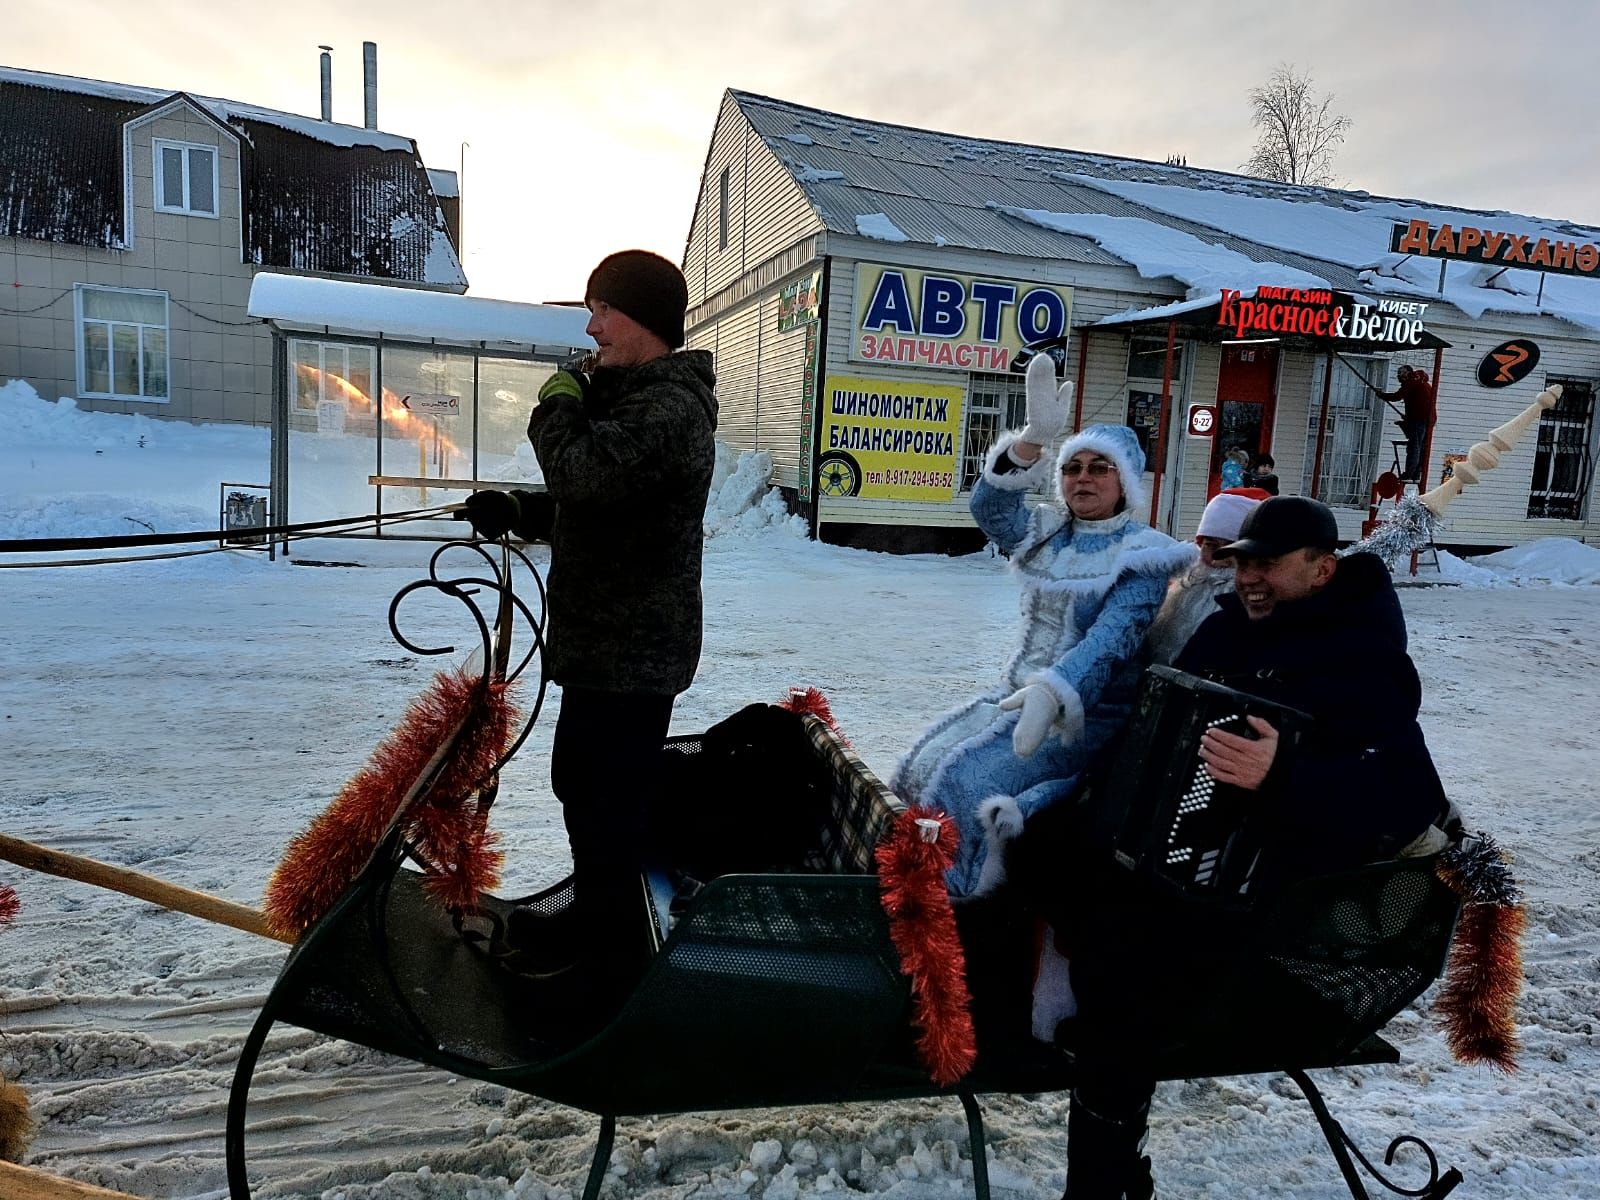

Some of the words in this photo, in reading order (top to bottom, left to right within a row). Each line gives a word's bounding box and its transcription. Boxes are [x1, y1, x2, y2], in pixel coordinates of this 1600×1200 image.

[1399, 219, 1599, 272] ДАРУХАНӘ
[861, 270, 1066, 344] АВТО
[1258, 286, 1332, 305] МАГАЗИН
[1379, 300, 1429, 316] КИБЕТ
[860, 335, 1009, 370] ЗАПЧАСТИ
[831, 390, 949, 422] ШИНОМОНТАЖ
[829, 424, 953, 456] БАЛАНСИРОВКА
[865, 471, 884, 485] тел:
[885, 469, 953, 488] 8-917-294-95-52
